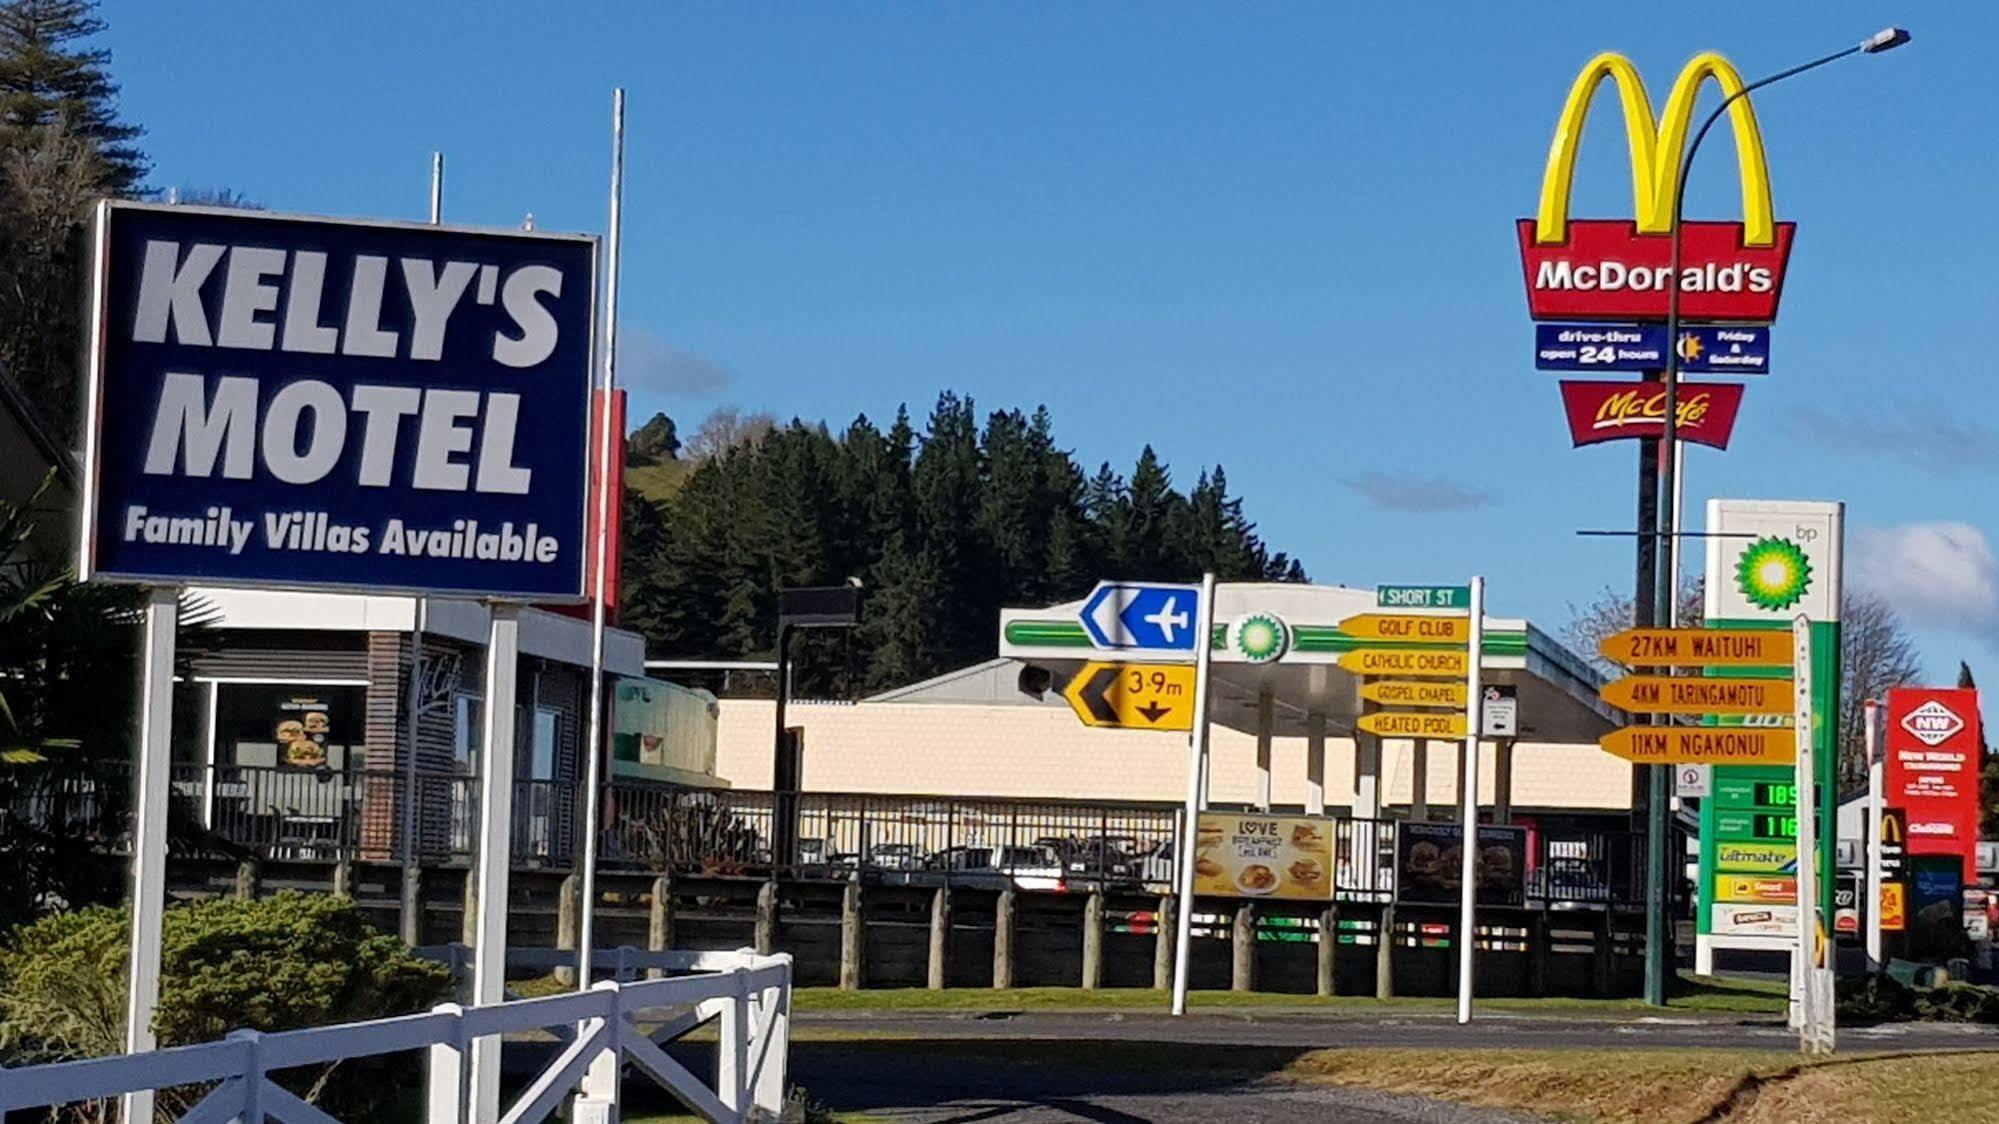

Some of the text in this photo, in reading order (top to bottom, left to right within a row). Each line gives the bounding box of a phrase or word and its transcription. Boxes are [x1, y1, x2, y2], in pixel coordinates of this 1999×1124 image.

[1535, 261, 1773, 293] McDonald's
[132, 240, 564, 368] KELLY'S
[1558, 330, 1642, 343] drive-thru
[1578, 345, 1617, 364] 24
[1618, 348, 1660, 361] hours
[143, 372, 532, 495] MOTEL
[123, 504, 559, 564] Family Villas Available
[1795, 524, 1818, 543] bp
[1387, 589, 1455, 606] SHORT ST
[1378, 619, 1455, 637] GOLF CLUB
[1630, 635, 1763, 659] 27KM WAITUHI
[1363, 653, 1462, 671] CATHOLIC CHURCH
[1377, 686, 1456, 702] GOSPEL CHAPEL
[1630, 683, 1765, 707] 4KM TARINGAMOTU
[1374, 717, 1455, 734] HEATED POOL
[1914, 716, 1950, 730] NW
[1630, 732, 1766, 756] 11KM NGAKONUI
